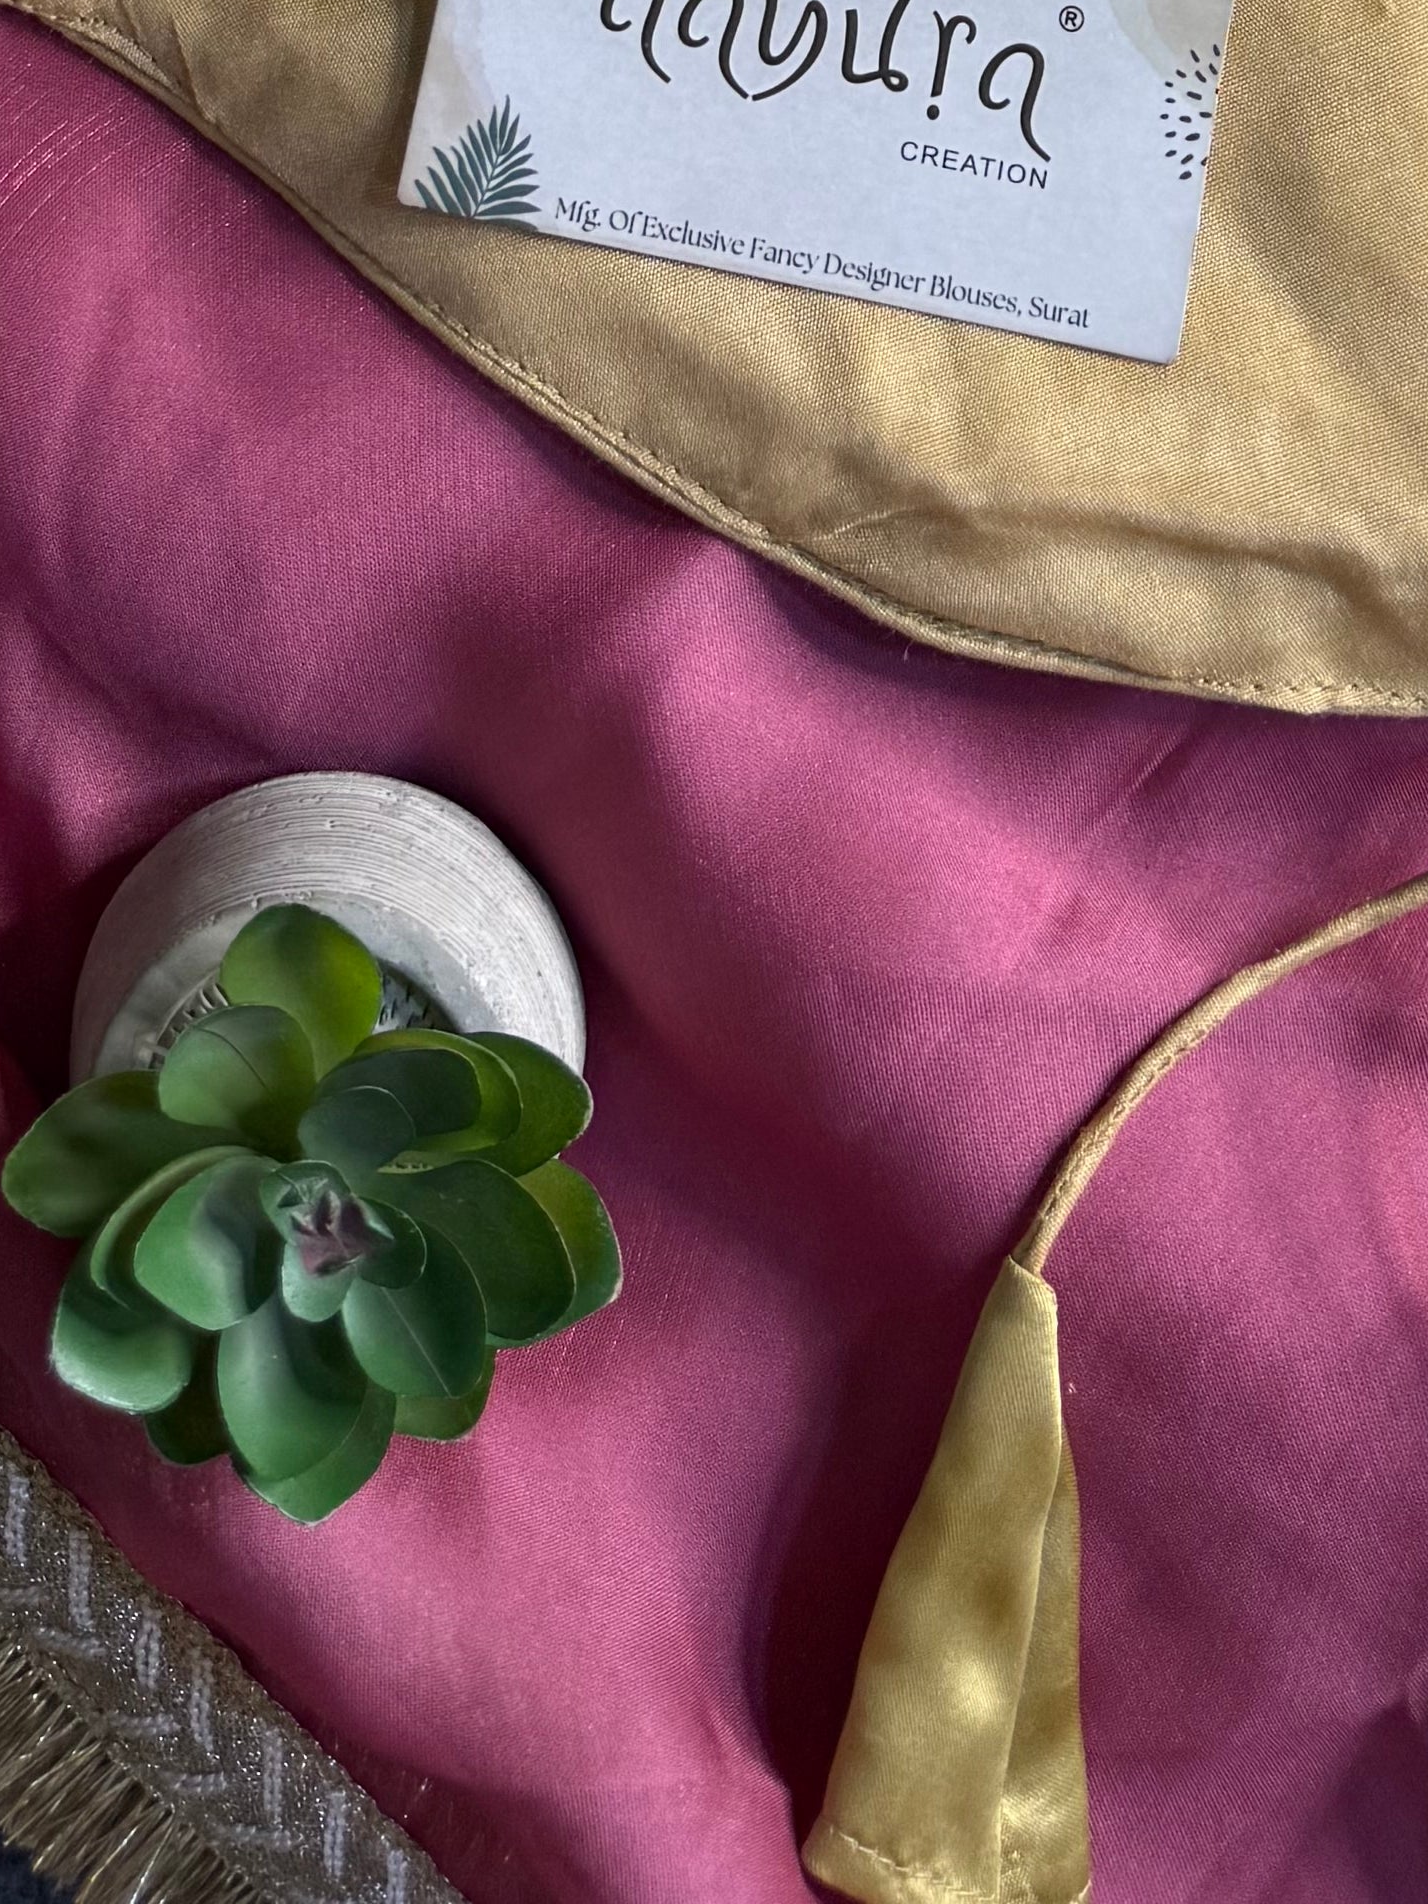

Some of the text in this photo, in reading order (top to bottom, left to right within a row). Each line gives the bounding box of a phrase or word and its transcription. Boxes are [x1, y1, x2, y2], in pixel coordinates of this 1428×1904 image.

[899, 140, 1049, 190] CREATION
[554, 196, 1090, 329] Mfg. Of Exclusive Fancy Designer Blouses, Surat
